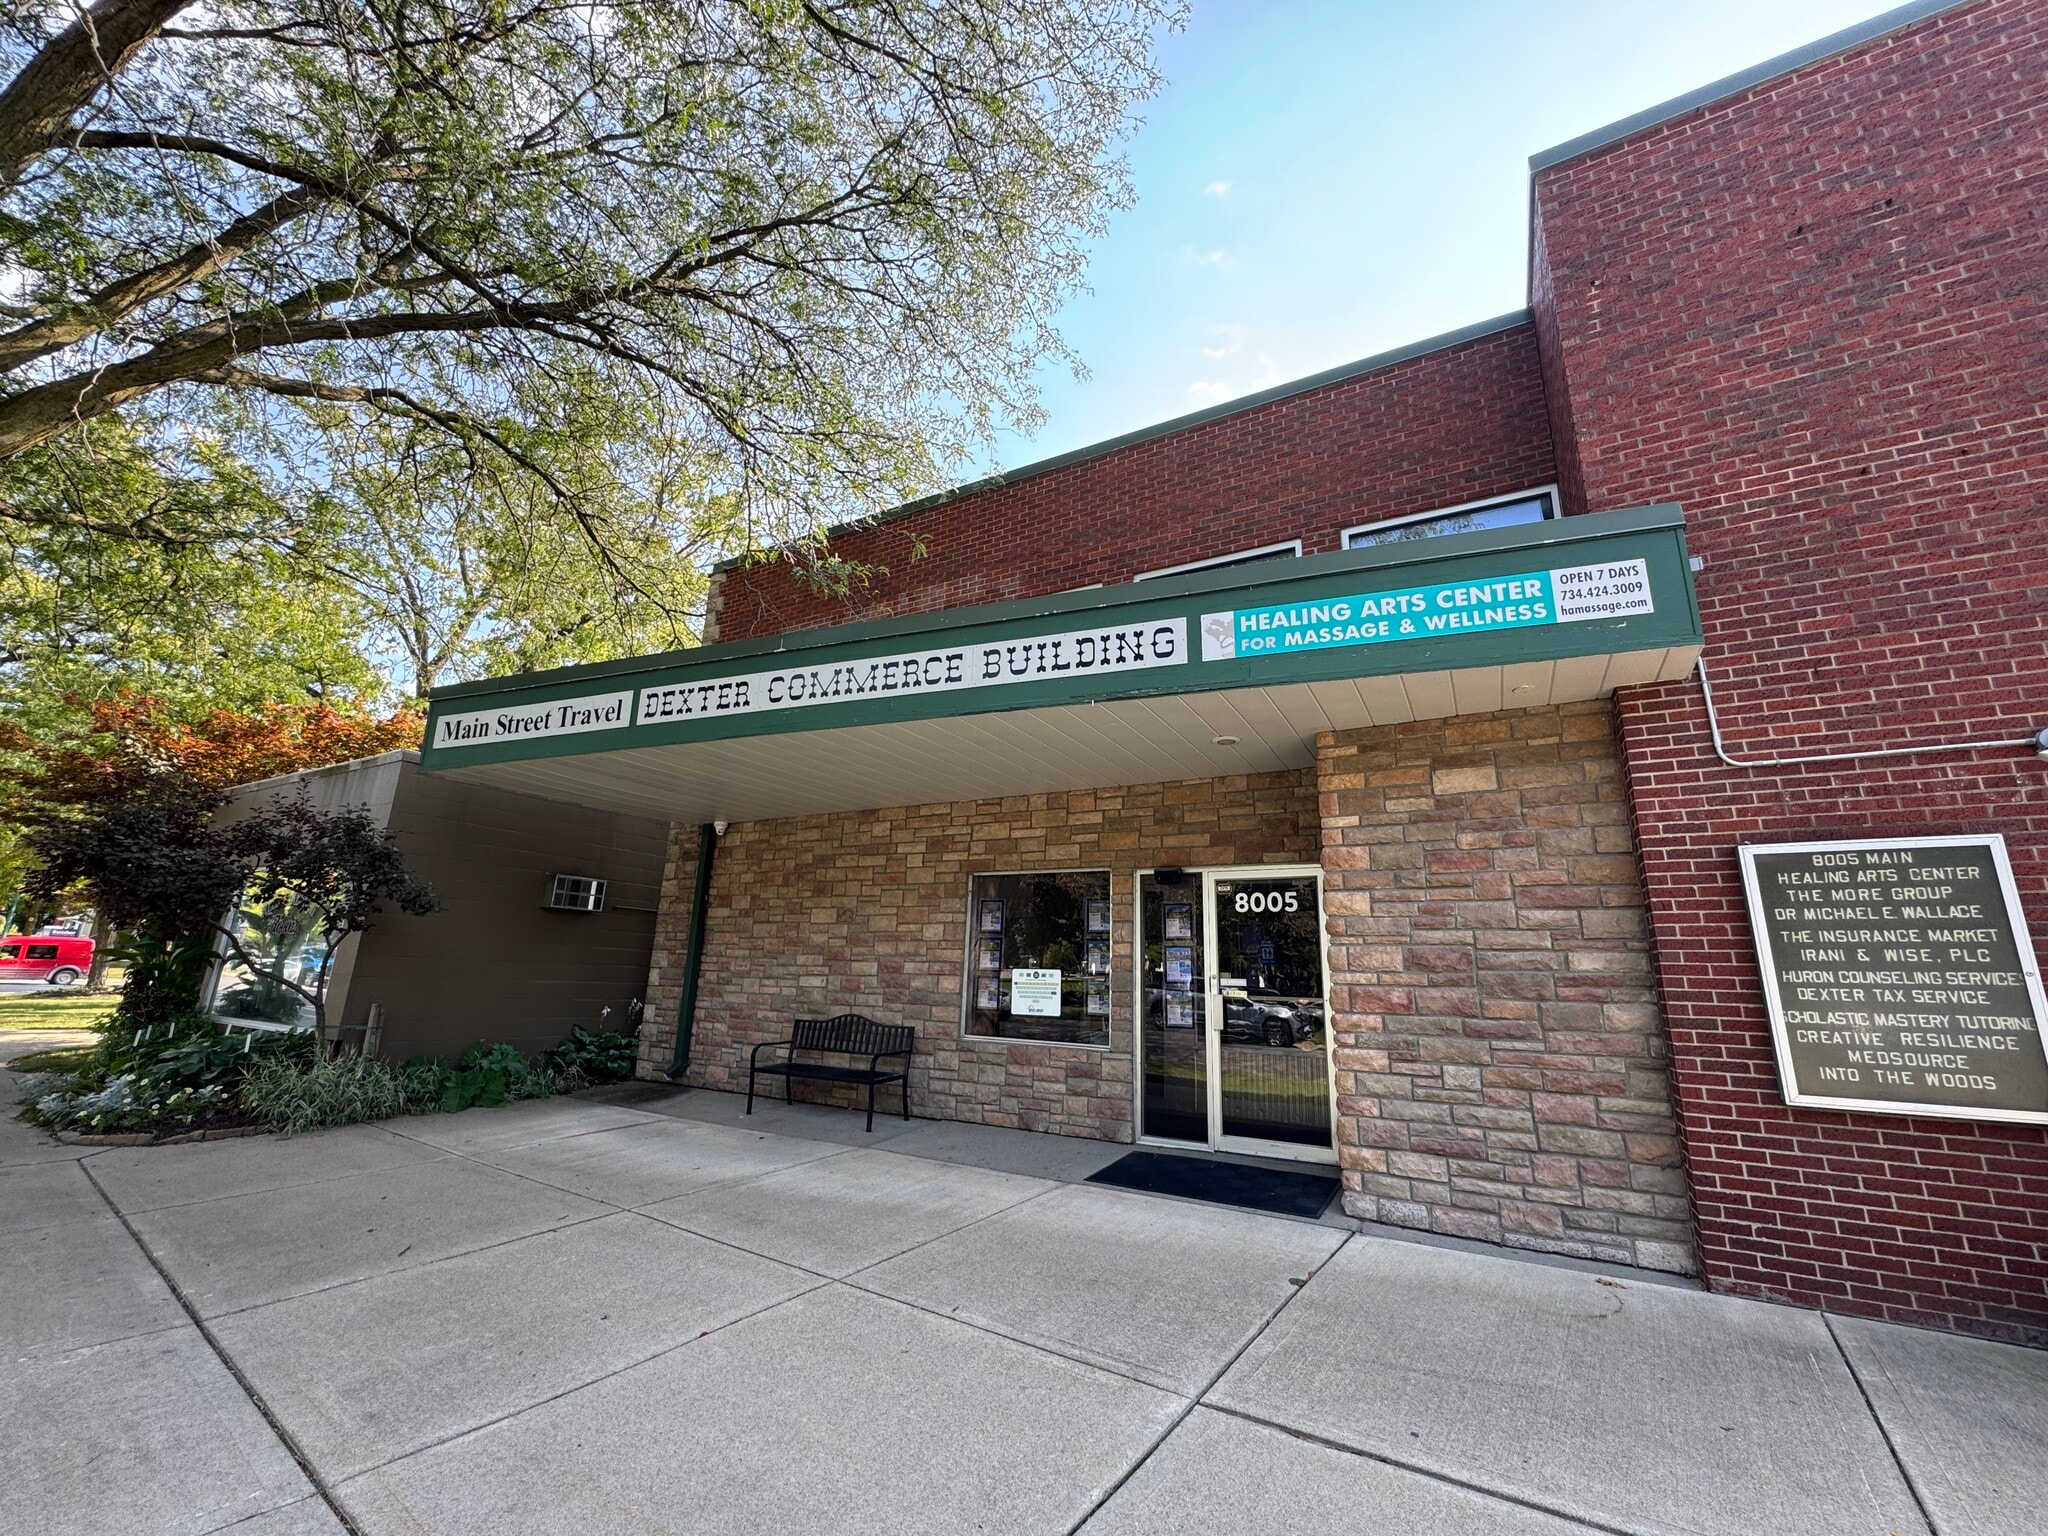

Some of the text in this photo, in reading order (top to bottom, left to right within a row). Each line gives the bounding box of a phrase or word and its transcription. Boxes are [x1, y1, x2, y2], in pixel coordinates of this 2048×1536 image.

[1560, 565, 1640, 586] OPEN 7 DAYS
[1560, 582, 1643, 601] 734.424.3009
[1239, 579, 1542, 632] HEALING ARTS CENTER
[1560, 597, 1648, 616] hamassage.com
[1240, 603, 1548, 652] FOR MASSAGE & WELLNESS
[643, 626, 1176, 719] DEXTER COMMERCE BUILDING
[441, 699, 623, 742] Main Street Travel
[1812, 851, 1913, 867] 8005 MAIN
[1777, 866, 1981, 885] HEALING ARTS CENTER
[1234, 891, 1298, 914] 8005
[1786, 886, 1953, 903] THE MORE GROUP
[1774, 905, 1984, 921] DR MICHAEL E. WALLACE
[1780, 928, 1999, 944] THE INSURANCE MARKET
[1800, 949, 1846, 962] IRANI
[1856, 949, 1870, 962] &
[1950, 948, 1991, 963] PLC
[1782, 970, 1833, 984] HURON
[1838, 970, 1942, 986] COUNSELING
[1796, 987, 1991, 1006] DEXTER TAX SERVICE
[1873, 1012, 1950, 1029] MASTERY
[1796, 1029, 2020, 1051] CREATIVE RESILIENCE
[1847, 1049, 1970, 1070] MEDSOURCE
[1819, 1066, 1997, 1091] INTO THE WOODS
